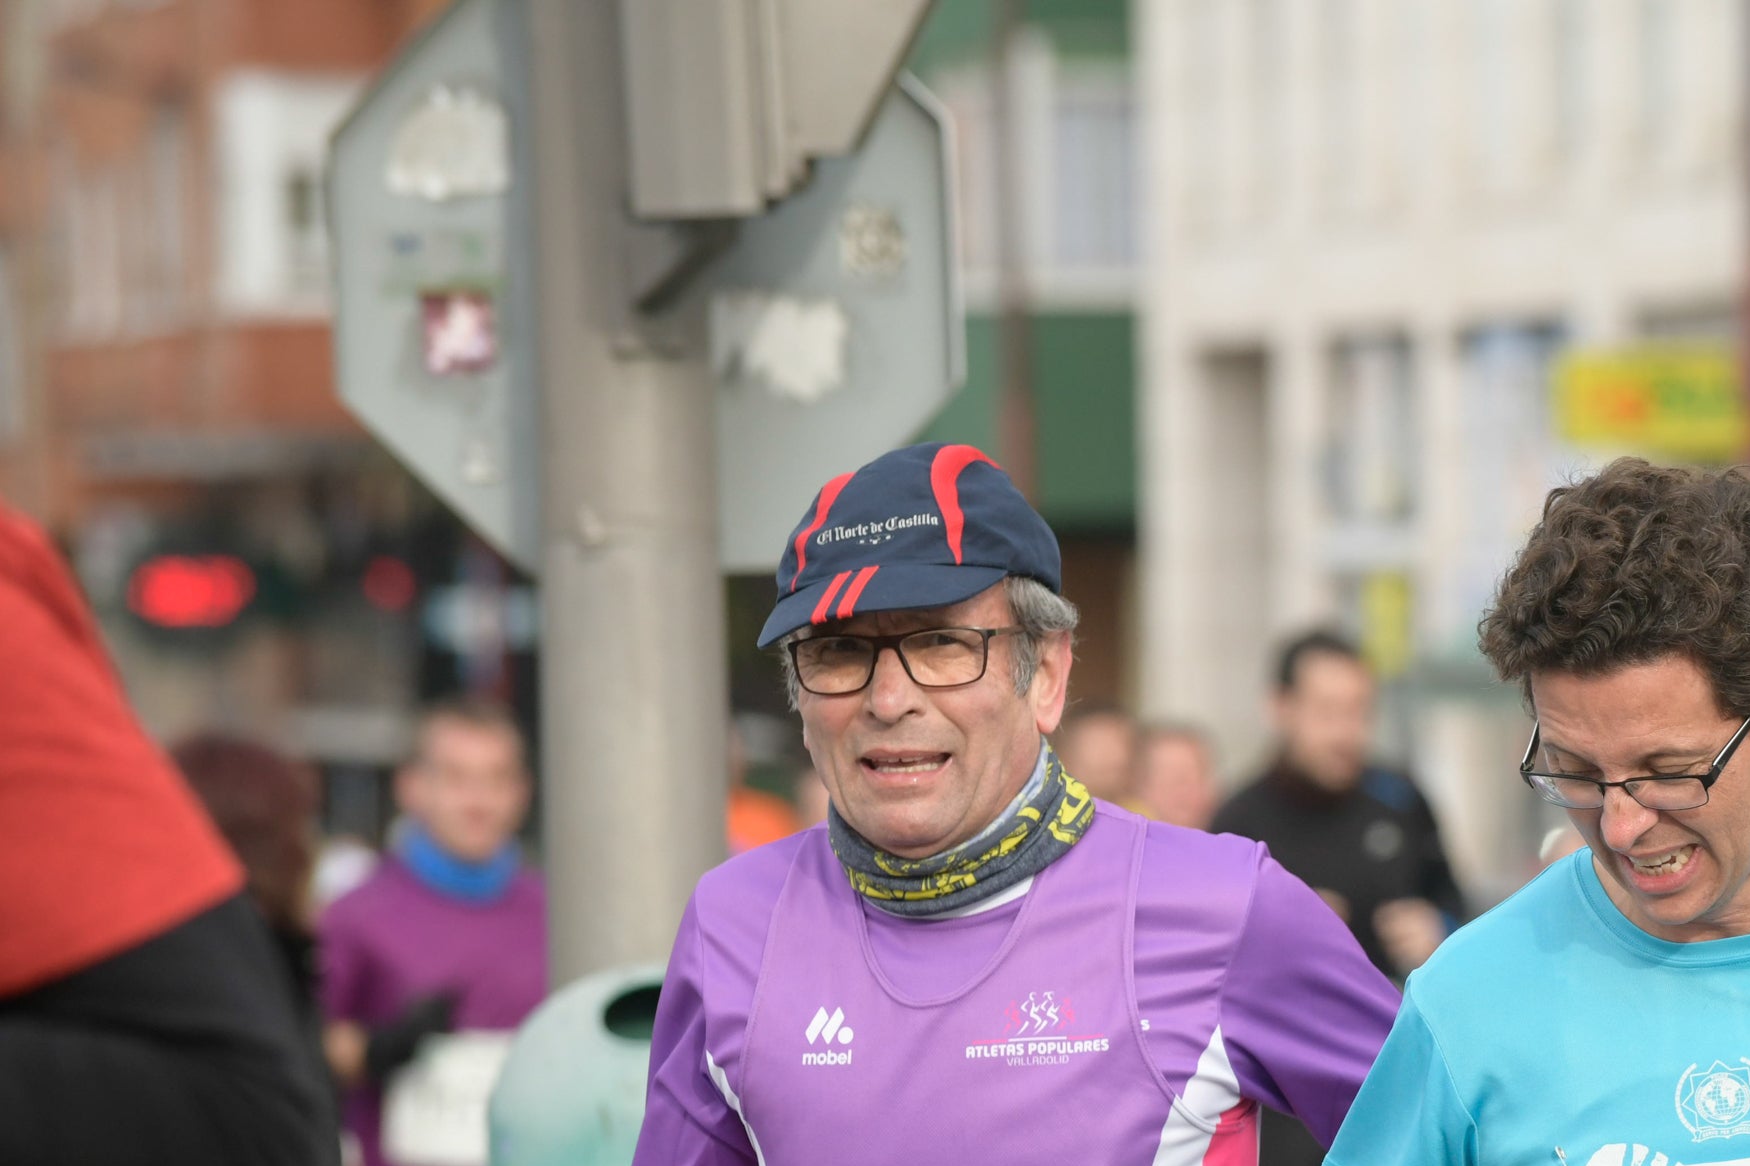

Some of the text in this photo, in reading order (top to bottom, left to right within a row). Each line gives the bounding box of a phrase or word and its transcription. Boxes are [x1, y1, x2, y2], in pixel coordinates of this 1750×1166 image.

[817, 513, 939, 545] El Norte de Castilla
[802, 1049, 852, 1066] mobel
[965, 1038, 1110, 1059] ATLETAS POPULARES
[1006, 1055, 1070, 1067] VALLADOLID
